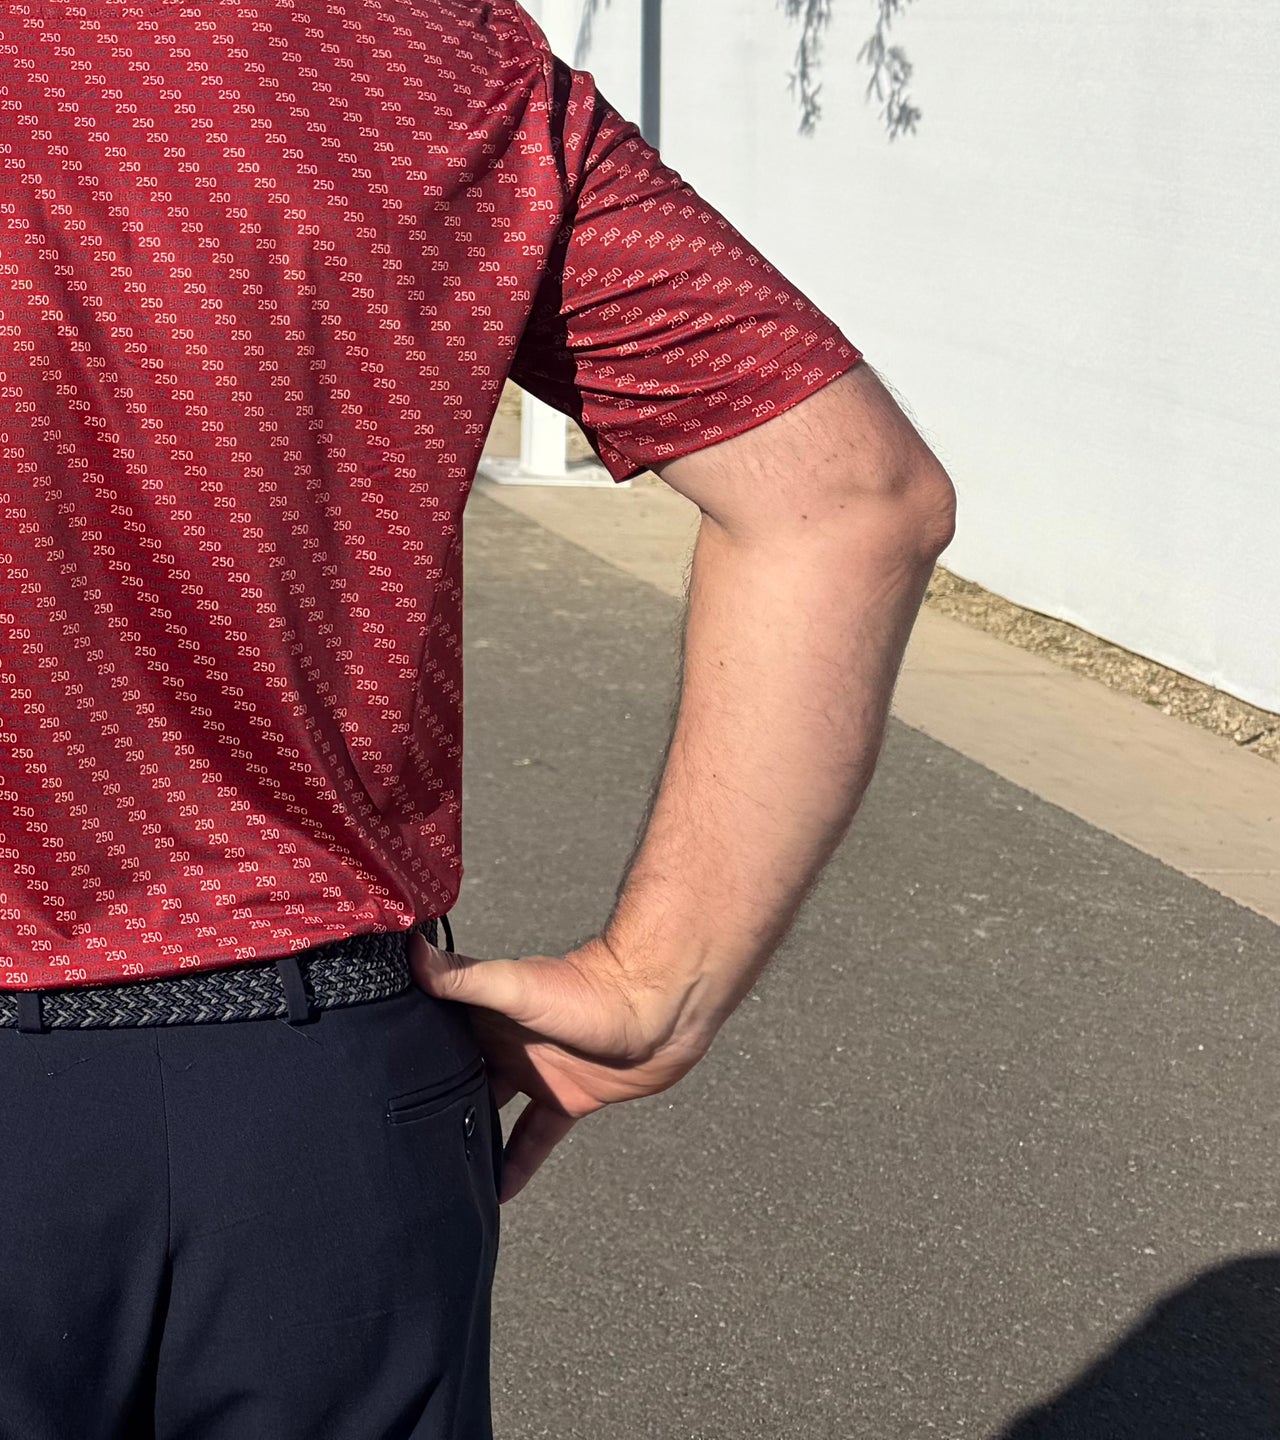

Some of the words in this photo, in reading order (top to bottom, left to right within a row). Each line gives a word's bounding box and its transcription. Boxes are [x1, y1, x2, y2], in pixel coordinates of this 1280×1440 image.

[8, 4, 31, 16] 250
[179, 7, 202, 18] 250
[79, 20, 101, 31] 250
[355, 33, 376, 45] 250
[258, 76, 280, 88] 250
[159, 89, 182, 100] 250
[57, 101, 80, 113] 250
[394, 115, 416, 127] 250
[118, 161, 141, 172] 250
[313, 179, 335, 191] 250
[208, 191, 231, 203] 250
[50, 204, 73, 216] 250
[381, 198, 403, 210] 250
[529, 199, 554, 212] 250
[638, 197, 657, 213] 250
[138, 236, 161, 248] 250
[454, 231, 473, 243] 250
[644, 230, 665, 249] 250
[312, 239, 336, 252] 250
[688, 236, 707, 253] 250
[382, 258, 403, 270] 250
[228, 268, 250, 280] 250
[647, 268, 670, 287] 250
[712, 276, 733, 295] 250
[27, 294, 50, 306] 250
[510, 290, 531, 302] 250
[270, 314, 291, 326] 250
[620, 306, 643, 325] 250
[333, 329, 357, 342] 250
[756, 320, 778, 339] 250
[124, 342, 148, 354] 250
[185, 343, 208, 356] 250
[405, 350, 427, 362] 250
[662, 346, 685, 365] 250
[708, 353, 732, 372] 250
[756, 359, 780, 378] 250
[470, 365, 491, 376] 250
[802, 367, 824, 386] 250
[56, 384, 78, 396] 250
[231, 390, 253, 402] 250
[751, 399, 776, 418] 250
[140, 417, 164, 430] 250
[354, 419, 378, 431] 250
[2, 447, 25, 459] 250
[230, 451, 252, 463] 250
[437, 453, 457, 464] 250
[141, 478, 164, 490] 250
[68, 516, 87, 528] 250
[281, 510, 300, 522] 250
[198, 540, 222, 552] 250
[344, 534, 366, 546] 250
[413, 554, 433, 566] 250
[362, 622, 385, 634] 250
[119, 630, 142, 642] 250
[224, 629, 248, 642] 250
[22, 642, 44, 655] 250
[265, 676, 288, 688] 250
[380, 709, 402, 720] 250
[39, 716, 60, 729] 250
[114, 736, 133, 749] 250
[189, 758, 210, 770] 250
[41, 777, 63, 789] 250
[194, 818, 215, 831] 250
[55, 851, 77, 863] 250
[237, 861, 259, 874] 250
[146, 883, 167, 896] 250
[322, 885, 342, 898] 250
[16, 924, 38, 936] 250
[64, 968, 87, 982] 250
